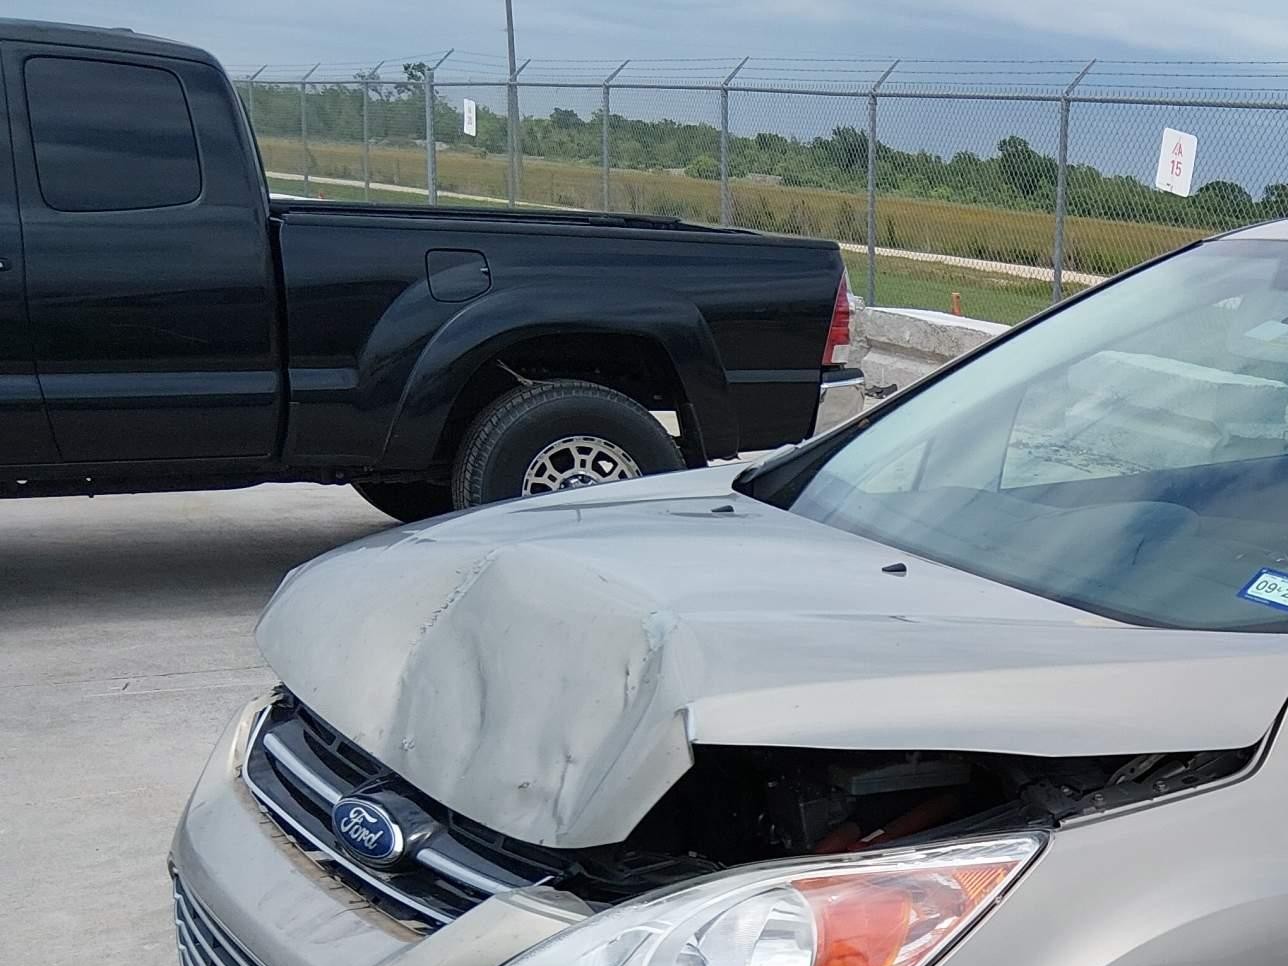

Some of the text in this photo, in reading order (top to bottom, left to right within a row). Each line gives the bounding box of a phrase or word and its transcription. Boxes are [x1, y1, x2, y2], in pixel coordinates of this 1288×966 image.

[1170, 159, 1183, 177] 15
[1255, 580, 1278, 594] 09
[340, 806, 384, 850] Ford
